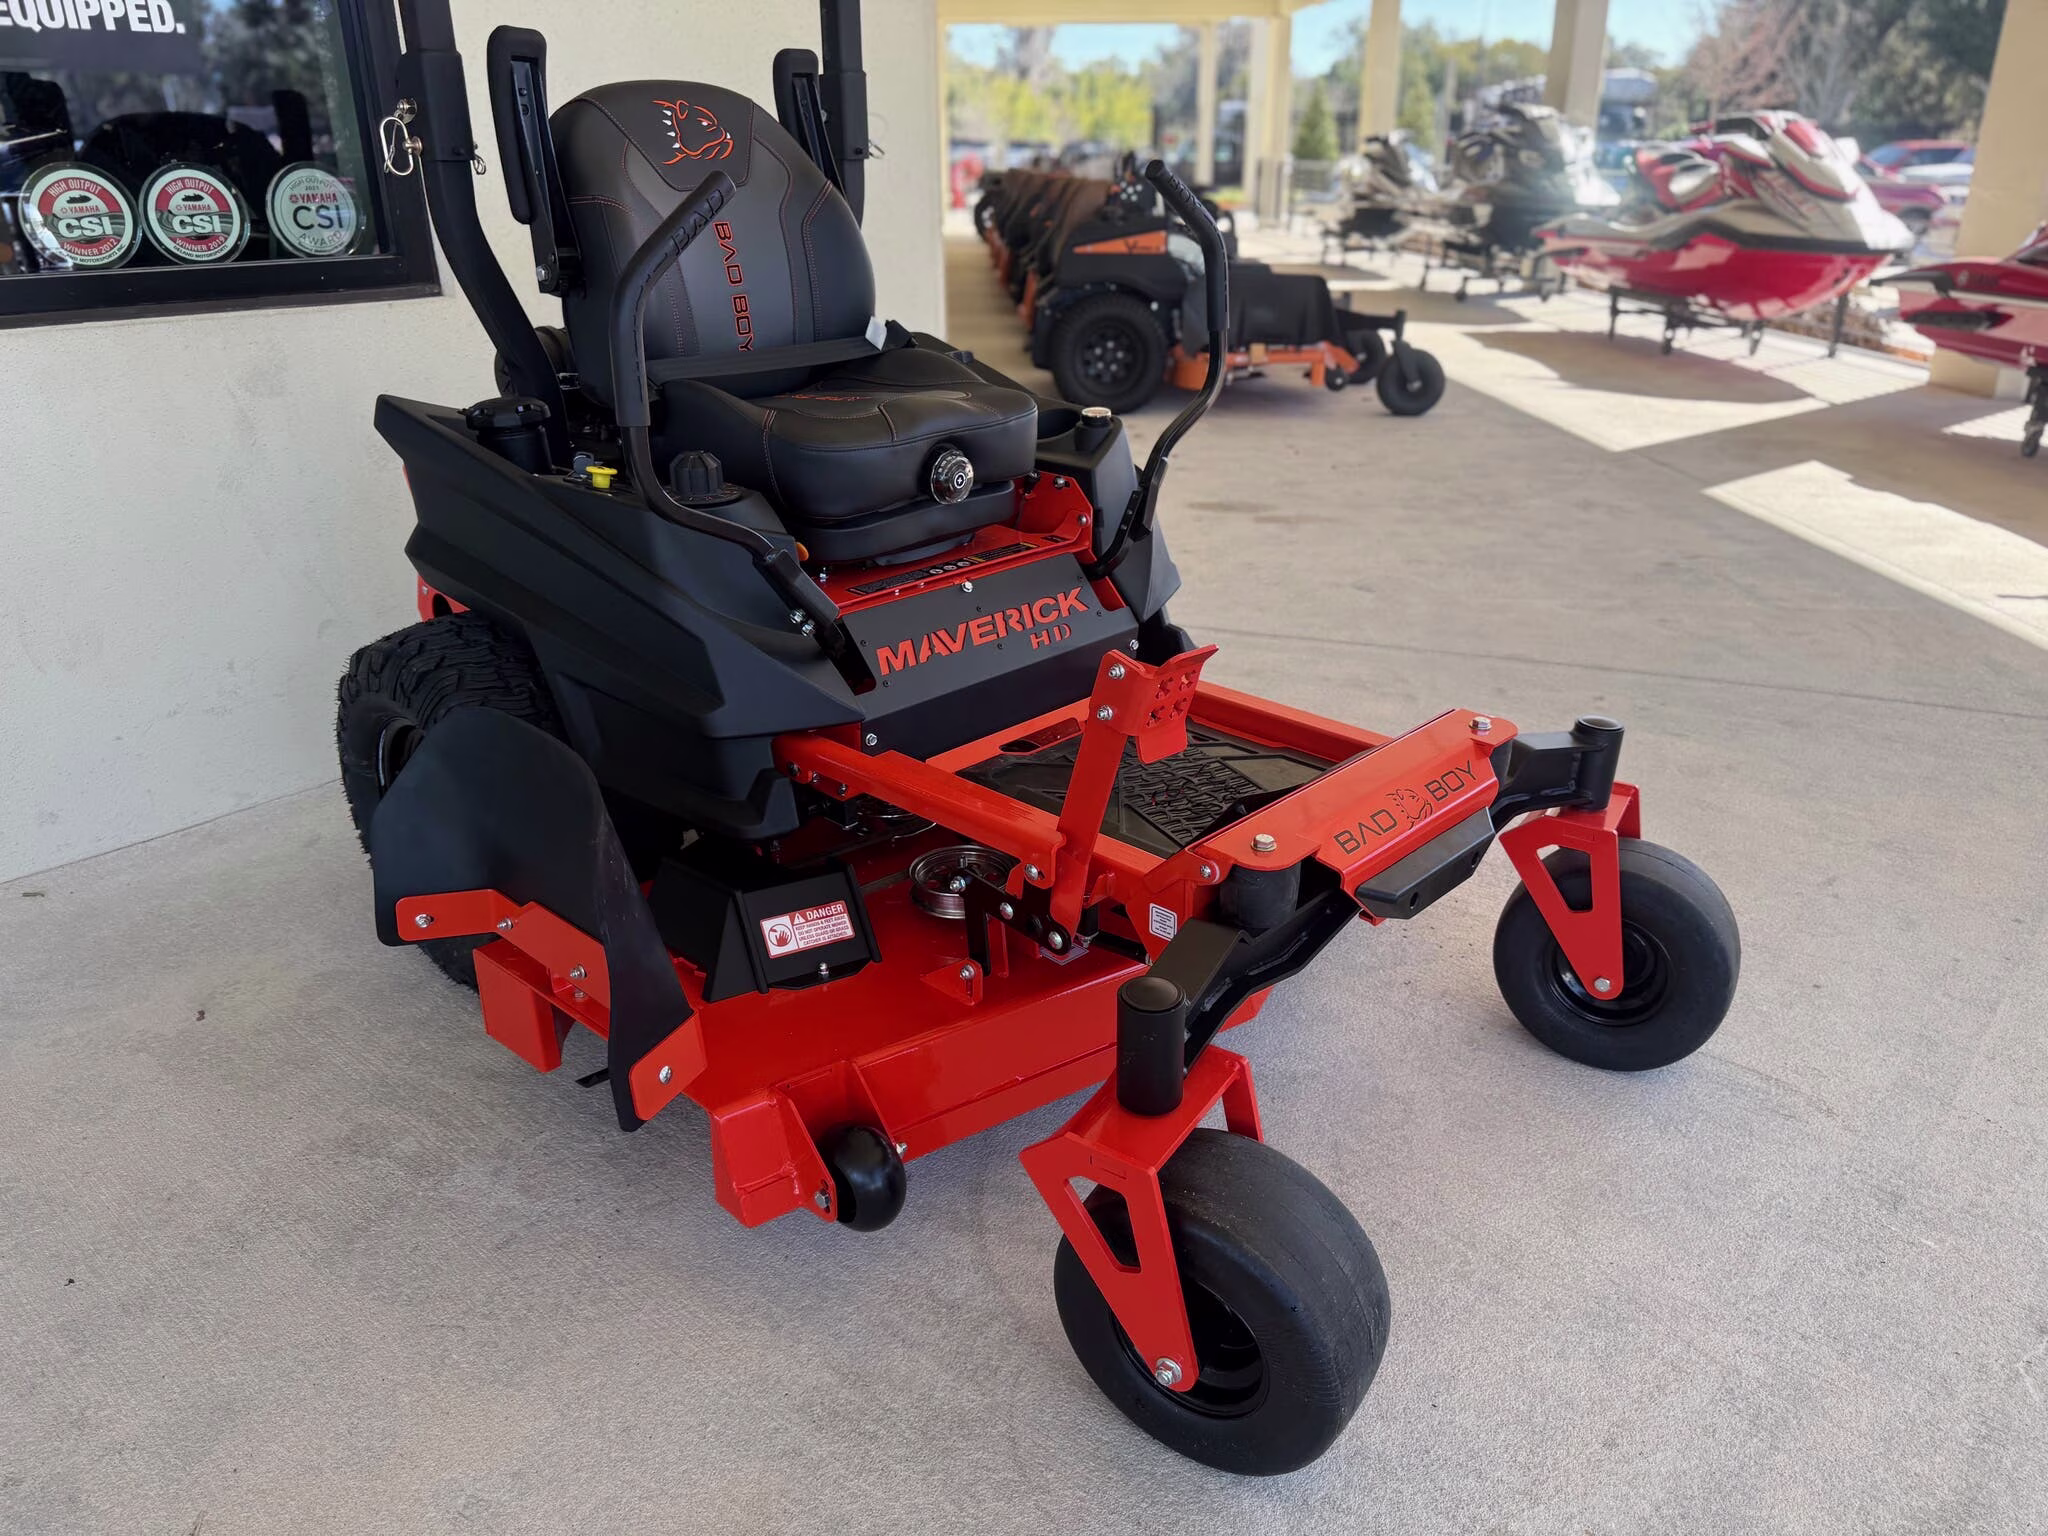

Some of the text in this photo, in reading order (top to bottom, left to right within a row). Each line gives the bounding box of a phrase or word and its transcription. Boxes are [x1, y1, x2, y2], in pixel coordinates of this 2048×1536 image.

[47, 179, 102, 197] HIGH OUTPUT
[165, 178, 215, 195] HIGH OUTPUT
[300, 192, 338, 204] YAMAHA
[69, 205, 100, 214] YAMAHA
[183, 204, 212, 212] YAMAHA
[172, 214, 222, 234] CSI
[292, 204, 344, 230] CSI
[58, 216, 113, 238] CSI
[176, 238, 208, 251] WINNER
[300, 231, 342, 246] AWARD
[63, 242, 99, 256] WINNER
[713, 221, 754, 351] BAD BOY
[876, 586, 1089, 676] MAVERICK
[1029, 623, 1072, 650] HD
[1333, 760, 1477, 855] BAD BOY
[806, 904, 844, 920] DANGER
